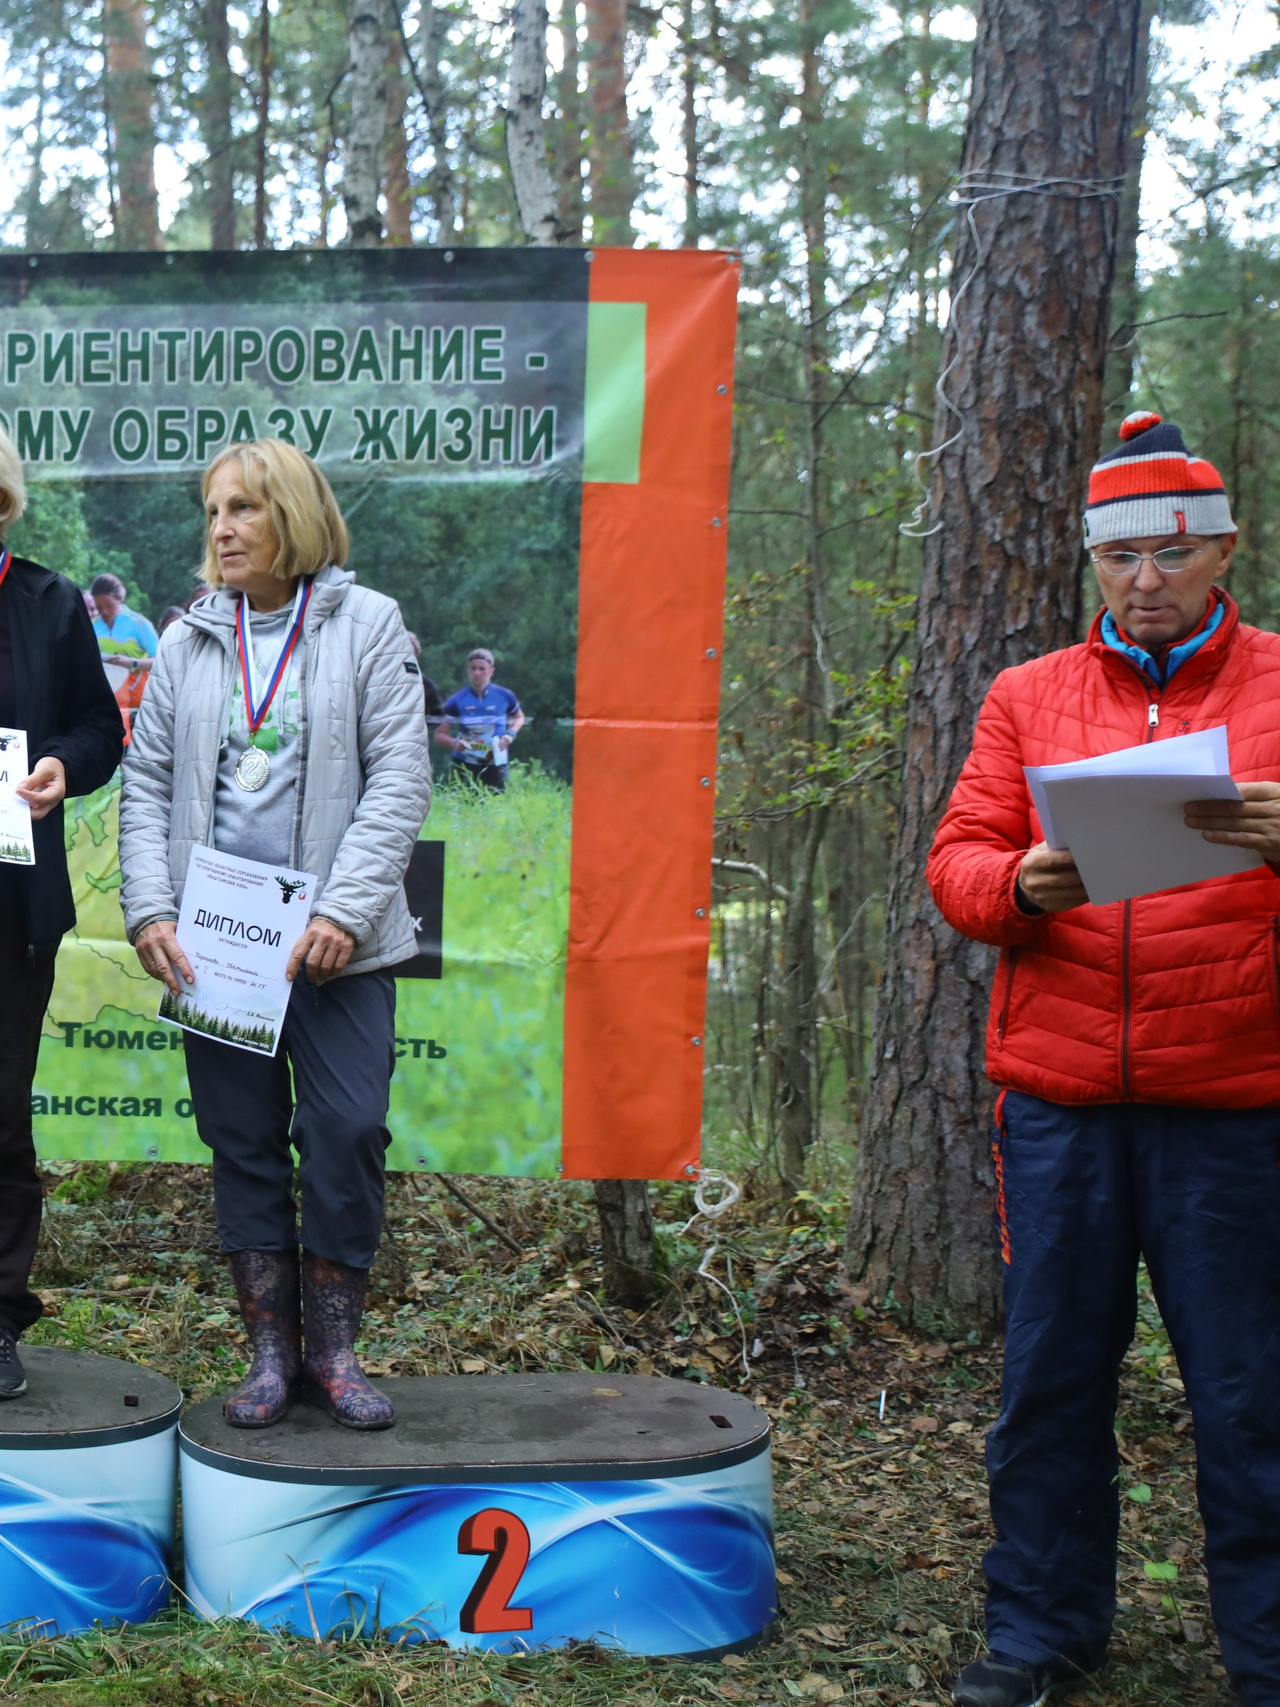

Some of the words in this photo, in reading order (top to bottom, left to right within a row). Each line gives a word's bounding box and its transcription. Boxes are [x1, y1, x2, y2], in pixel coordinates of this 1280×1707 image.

[112, 407, 332, 462] ОБРАЗУ
[354, 407, 556, 463] ЖИЗНИ
[244, 757, 261, 780] 2
[194, 908, 281, 947] ДИПЛОМ
[31, 1095, 162, 1117] анская
[457, 1507, 533, 1633] 2
